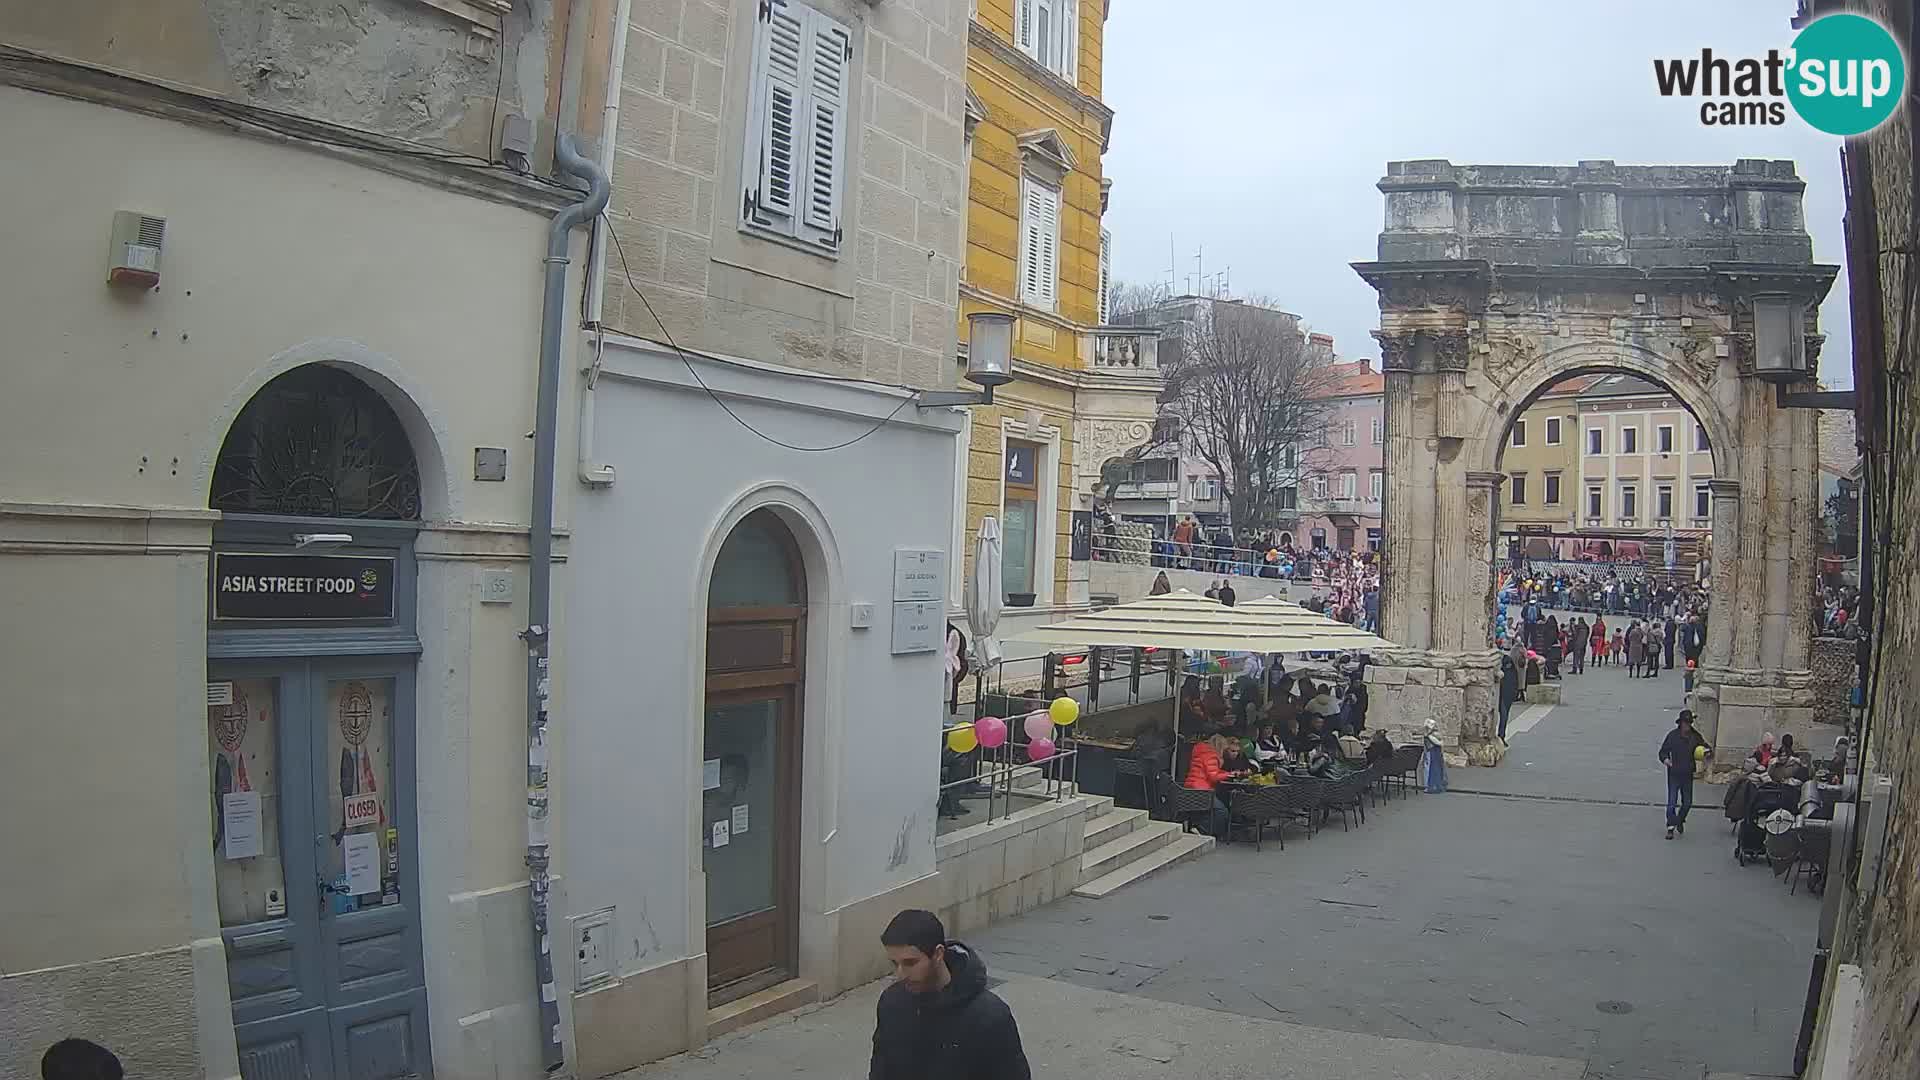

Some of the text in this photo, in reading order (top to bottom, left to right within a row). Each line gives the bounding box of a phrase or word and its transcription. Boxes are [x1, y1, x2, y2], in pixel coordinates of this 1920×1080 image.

[221, 575, 356, 594] ASIA STREET FOOD
[347, 799, 377, 820] CLOSED
